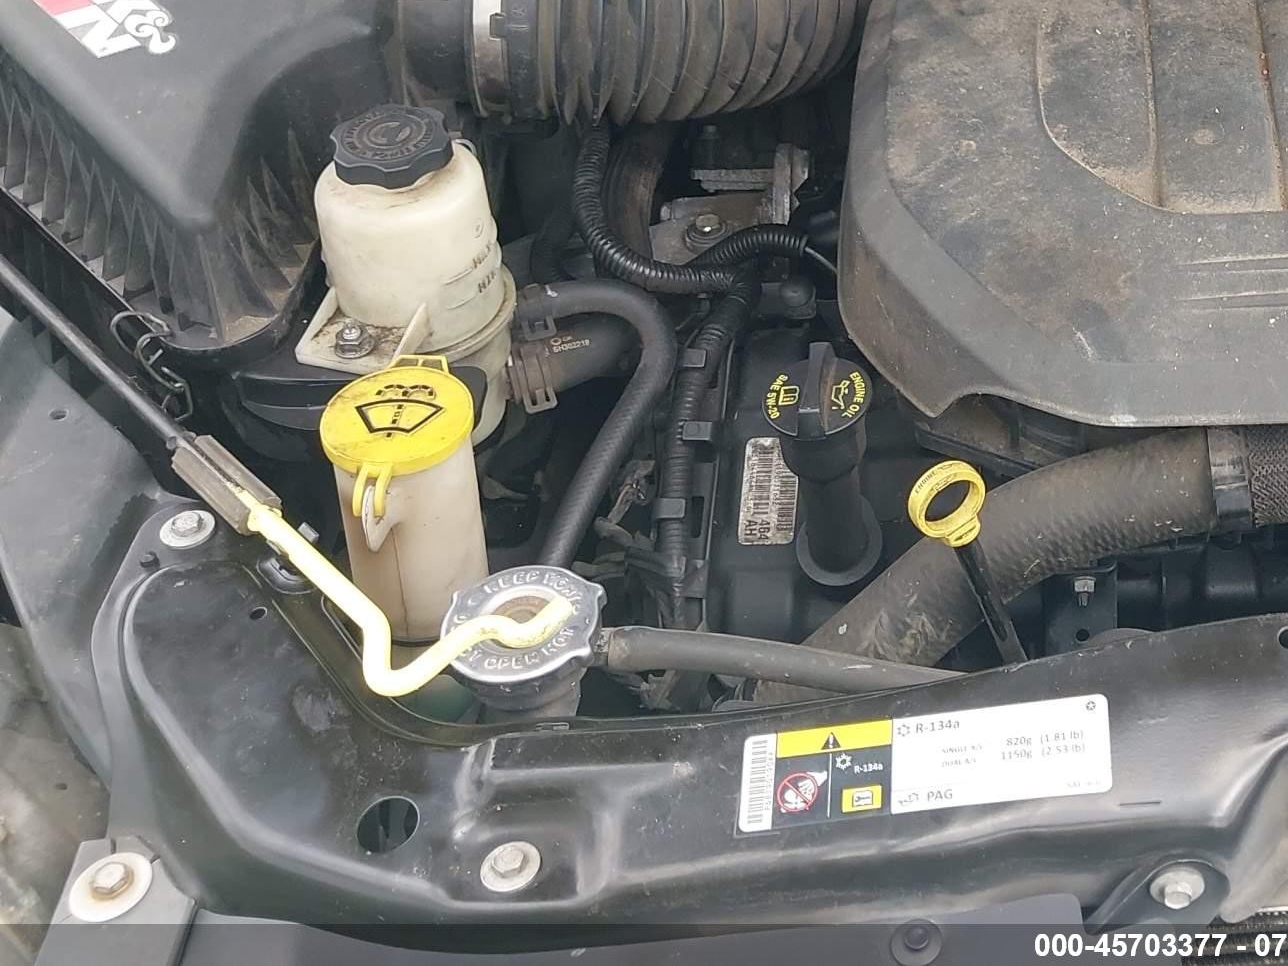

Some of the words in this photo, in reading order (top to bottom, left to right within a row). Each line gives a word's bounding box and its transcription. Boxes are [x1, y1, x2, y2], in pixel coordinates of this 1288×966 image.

[770, 373, 789, 392] SAE
[849, 372, 867, 405] ENGINE
[841, 405, 861, 419] OIL
[484, 652, 540, 670] OPEN
[915, 719, 960, 734] R-134a
[1006, 735, 1032, 748] 820g
[1001, 749, 1033, 761] 1150g
[853, 762, 884, 774] R-134a
[926, 788, 954, 803] PAG
